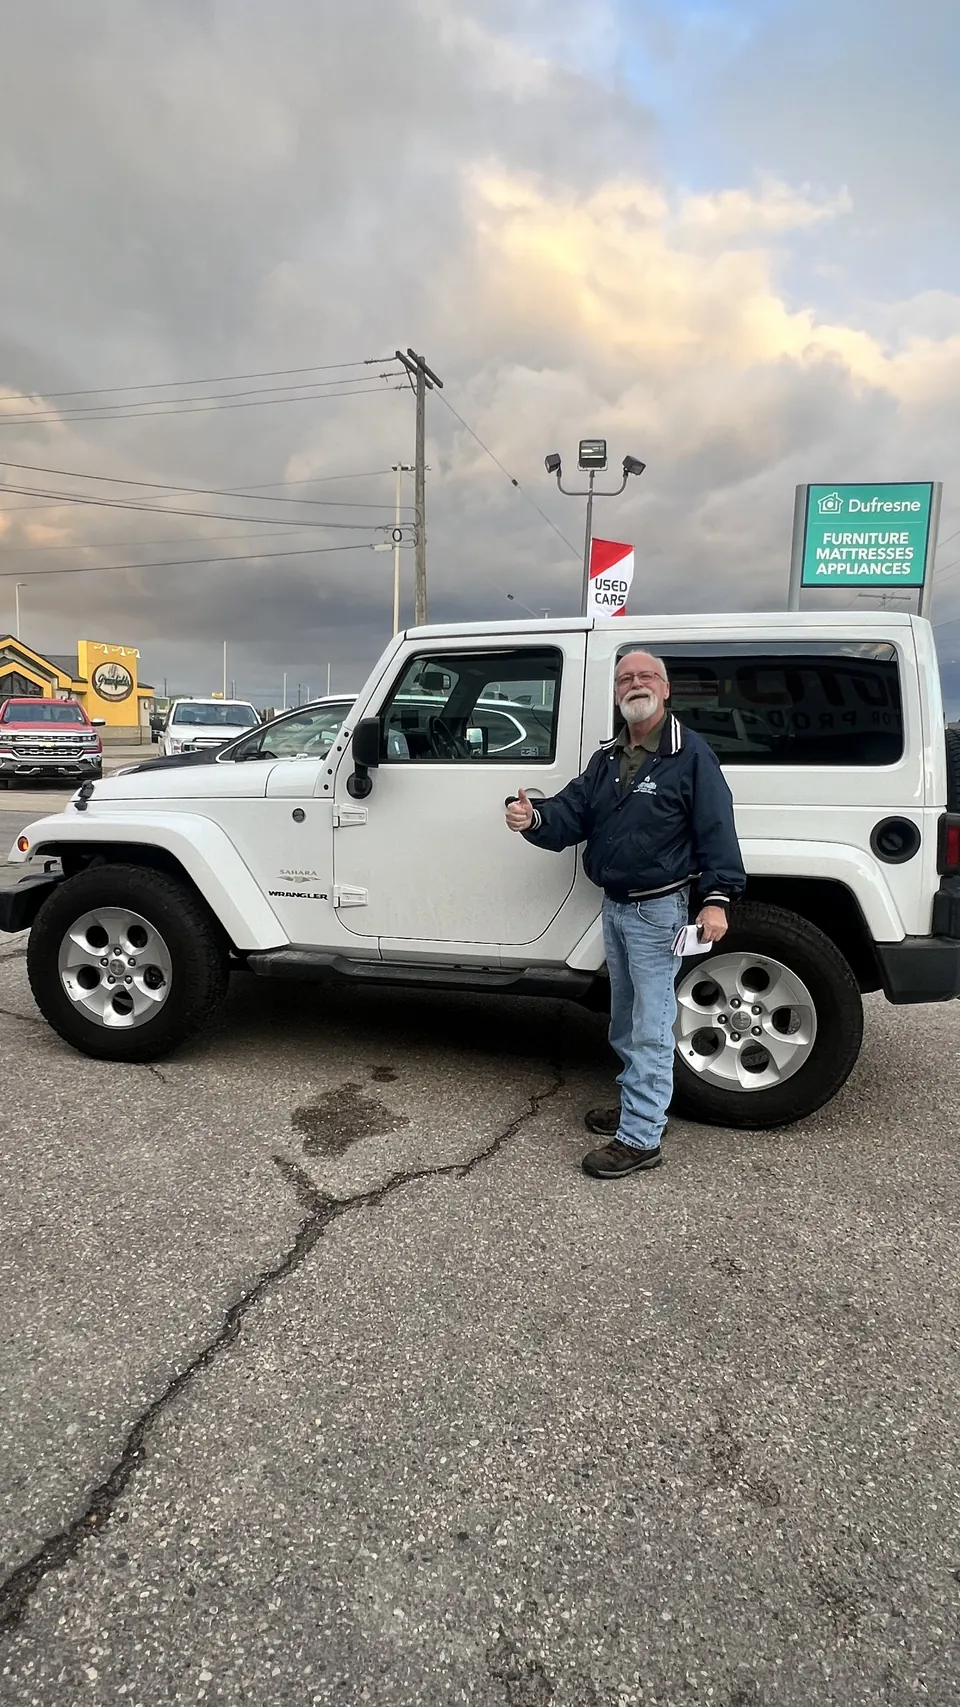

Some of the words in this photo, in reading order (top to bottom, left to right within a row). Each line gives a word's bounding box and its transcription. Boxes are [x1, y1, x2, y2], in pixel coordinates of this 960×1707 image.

[848, 497, 921, 513] Dufresne
[823, 532, 909, 545] FURNITURE
[816, 547, 914, 560] MATTRESSES
[816, 562, 911, 575] APPLIANCES
[595, 578, 628, 592] USED
[595, 593, 626, 606] CARS
[268, 890, 328, 900] WRANGLER
